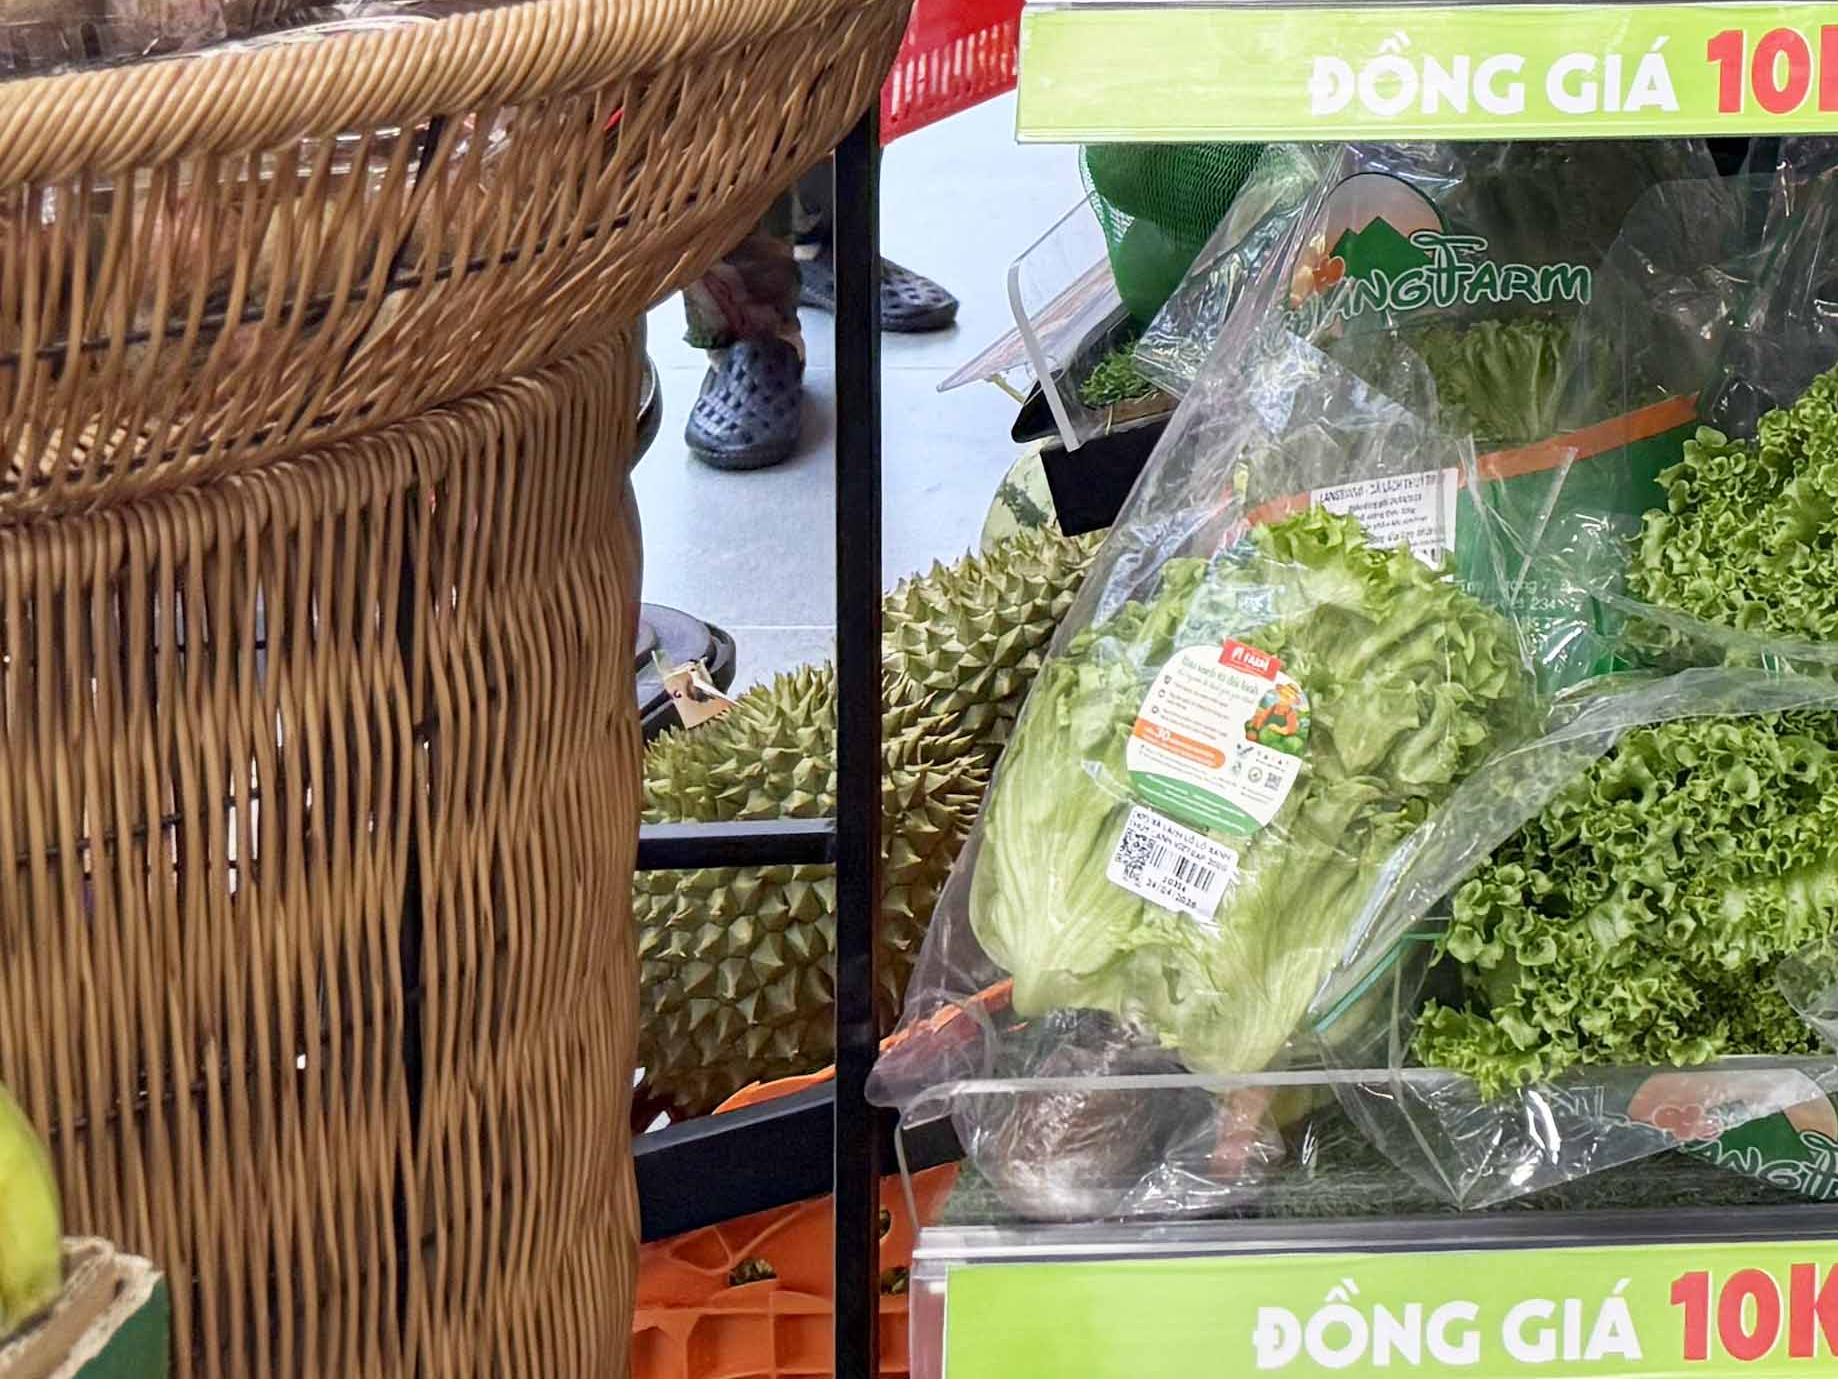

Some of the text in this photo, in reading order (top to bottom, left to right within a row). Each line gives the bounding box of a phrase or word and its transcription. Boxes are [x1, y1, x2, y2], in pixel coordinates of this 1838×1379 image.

[1306, 29, 1525, 119] ĐỒNG
[1545, 32, 1678, 115] GIÁ
[1251, 1281, 1480, 1371] ĐỒNG
[1502, 1277, 1642, 1364] GIÁ
